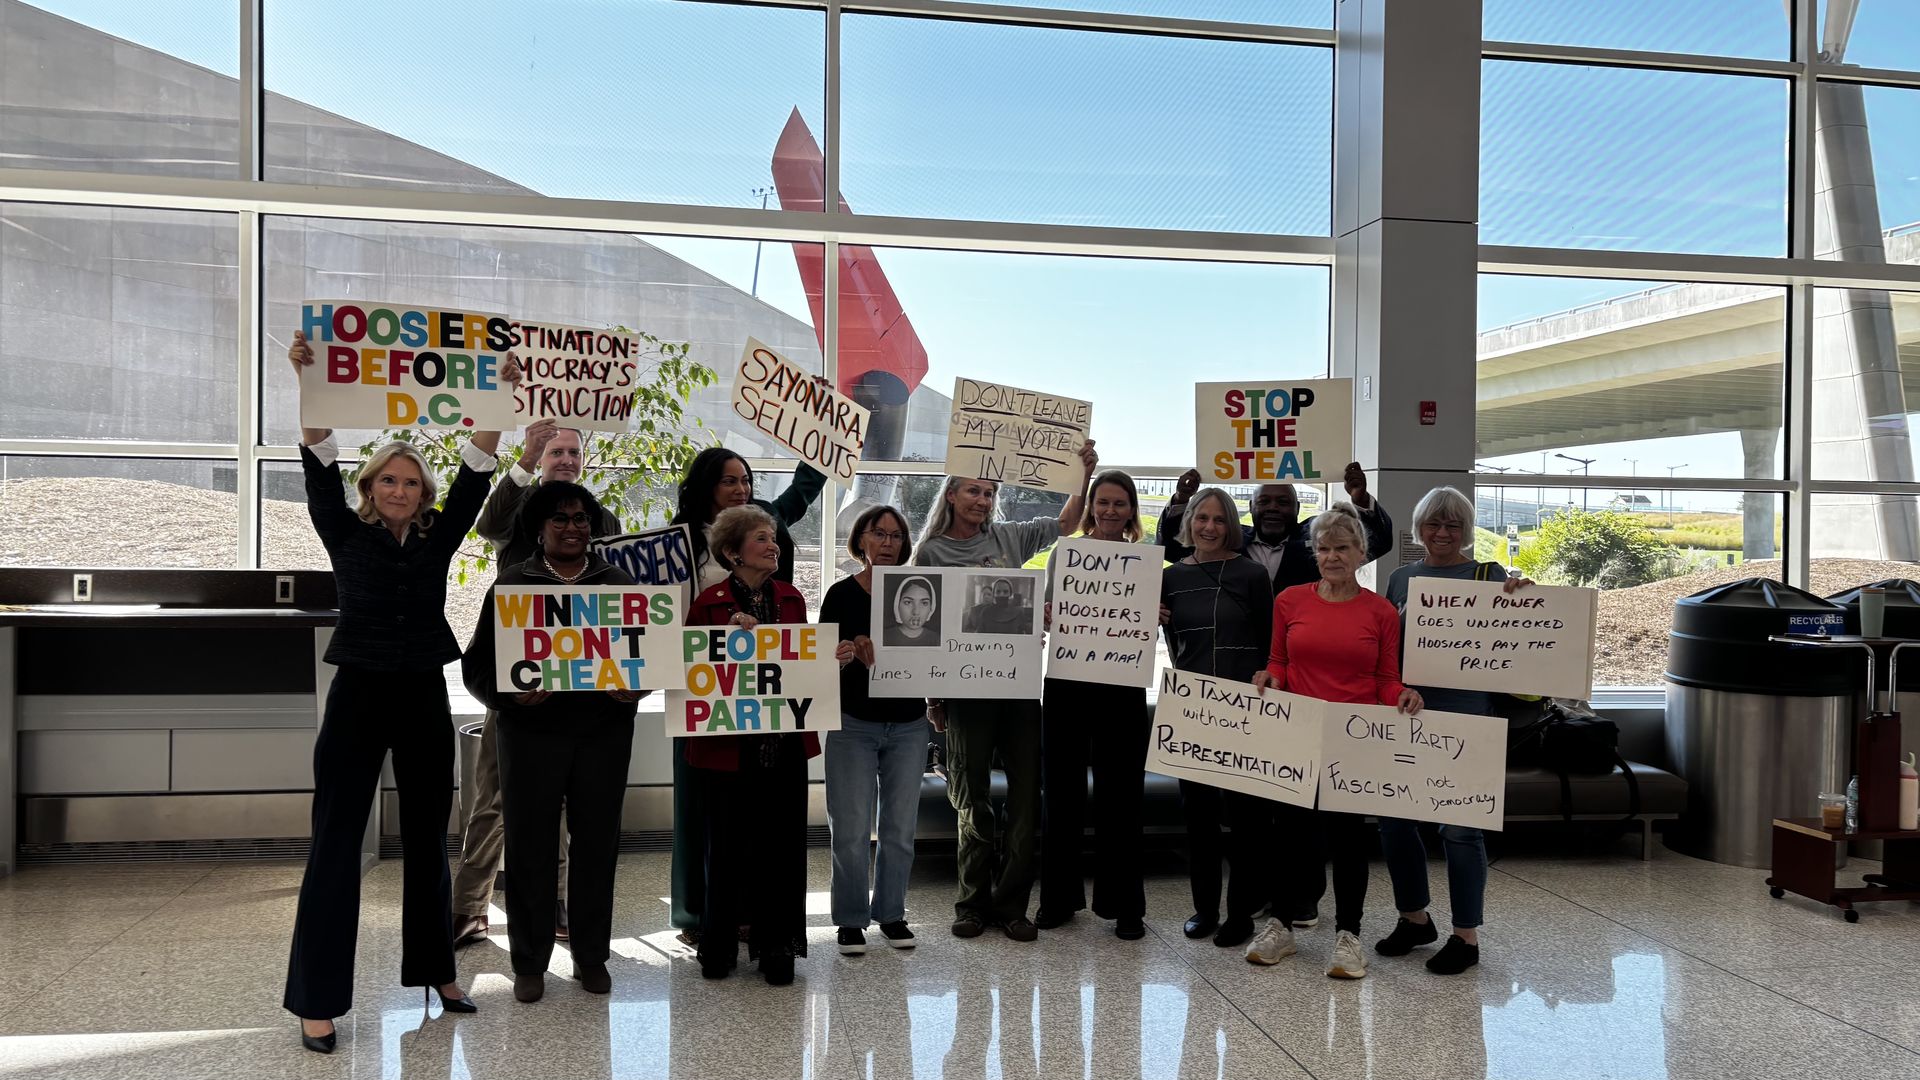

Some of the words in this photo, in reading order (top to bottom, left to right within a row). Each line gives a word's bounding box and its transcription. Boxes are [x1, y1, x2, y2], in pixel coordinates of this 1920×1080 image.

[302, 304, 511, 352] HOOSIERS
[510, 322, 639, 358] STINATION=
[327, 346, 497, 390] BEFORE
[515, 355, 637, 386] MOCRACY'S
[387, 393, 474, 427] D.C.
[513, 384, 635, 421] STRUCTION
[1033, 397, 1087, 423] LEAVE
[1224, 388, 1315, 418] STOP
[734, 386, 858, 479] SELLOUTS
[964, 420, 1003, 447] MY
[1017, 426, 1070, 451] VOTE
[1231, 418, 1298, 448] THE
[980, 454, 1006, 480] IN
[1020, 460, 1048, 480] DC
[1214, 451, 1321, 480] STEAL
[1066, 548, 1142, 575] DON'T
[1063, 574, 1136, 598] PUNISH
[1420, 593, 1477, 608] WHEN
[1492, 595, 1545, 608] POWER
[496, 593, 674, 627] WINNERS
[1059, 601, 1141, 623] HOOSIERS
[1417, 615, 1454, 628] GOES
[1466, 619, 1564, 629] UNCHECKED
[524, 627, 646, 661] DON'T
[683, 628, 816, 663] PEOPLE
[946, 639, 1015, 657] Drawing
[1106, 627, 1150, 641] LINES
[1417, 637, 1481, 649] HOOSIERS
[1491, 640, 1519, 651] PAY
[1527, 640, 1557, 649] THE
[871, 665, 912, 681] Lines
[928, 666, 947, 679] for
[959, 664, 1017, 680] Gilead
[1056, 646, 1078, 660] ON
[1085, 650, 1096, 662] A
[1104, 650, 1142, 669] MAP!
[1460, 656, 1513, 670] PRICE.
[510, 658, 646, 691] CHEAT
[687, 662, 782, 696] OVER
[686, 697, 814, 732] PARTY
[1195, 678, 1292, 722] TAXATION
[1183, 707, 1251, 735] without
[1346, 714, 1396, 741] ONE
[1410, 717, 1465, 760] PARTY
[1426, 775, 1456, 789] not
[1430, 793, 1496, 814] Democracy
